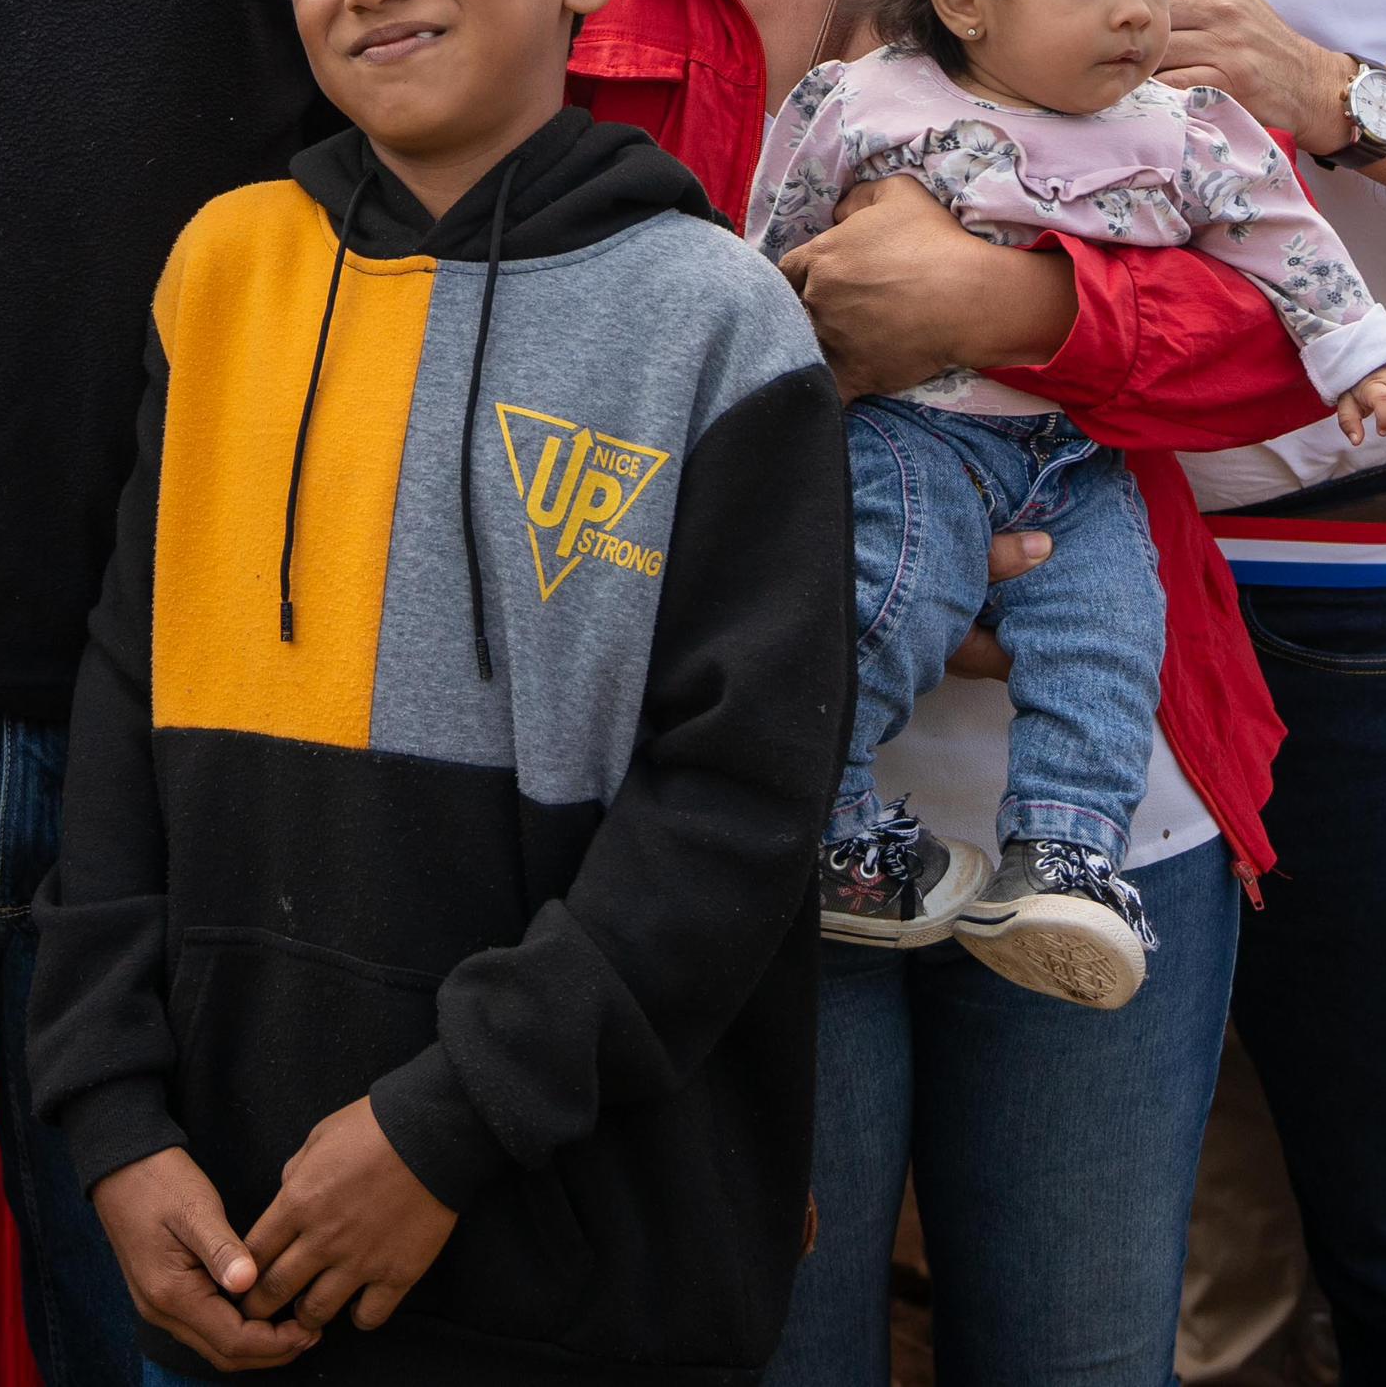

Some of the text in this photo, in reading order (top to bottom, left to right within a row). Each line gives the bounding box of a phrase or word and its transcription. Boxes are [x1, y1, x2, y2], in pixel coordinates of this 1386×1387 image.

[592, 445, 641, 479] NICE
[526, 427, 623, 558] UP
[577, 528, 663, 577] STRONG
